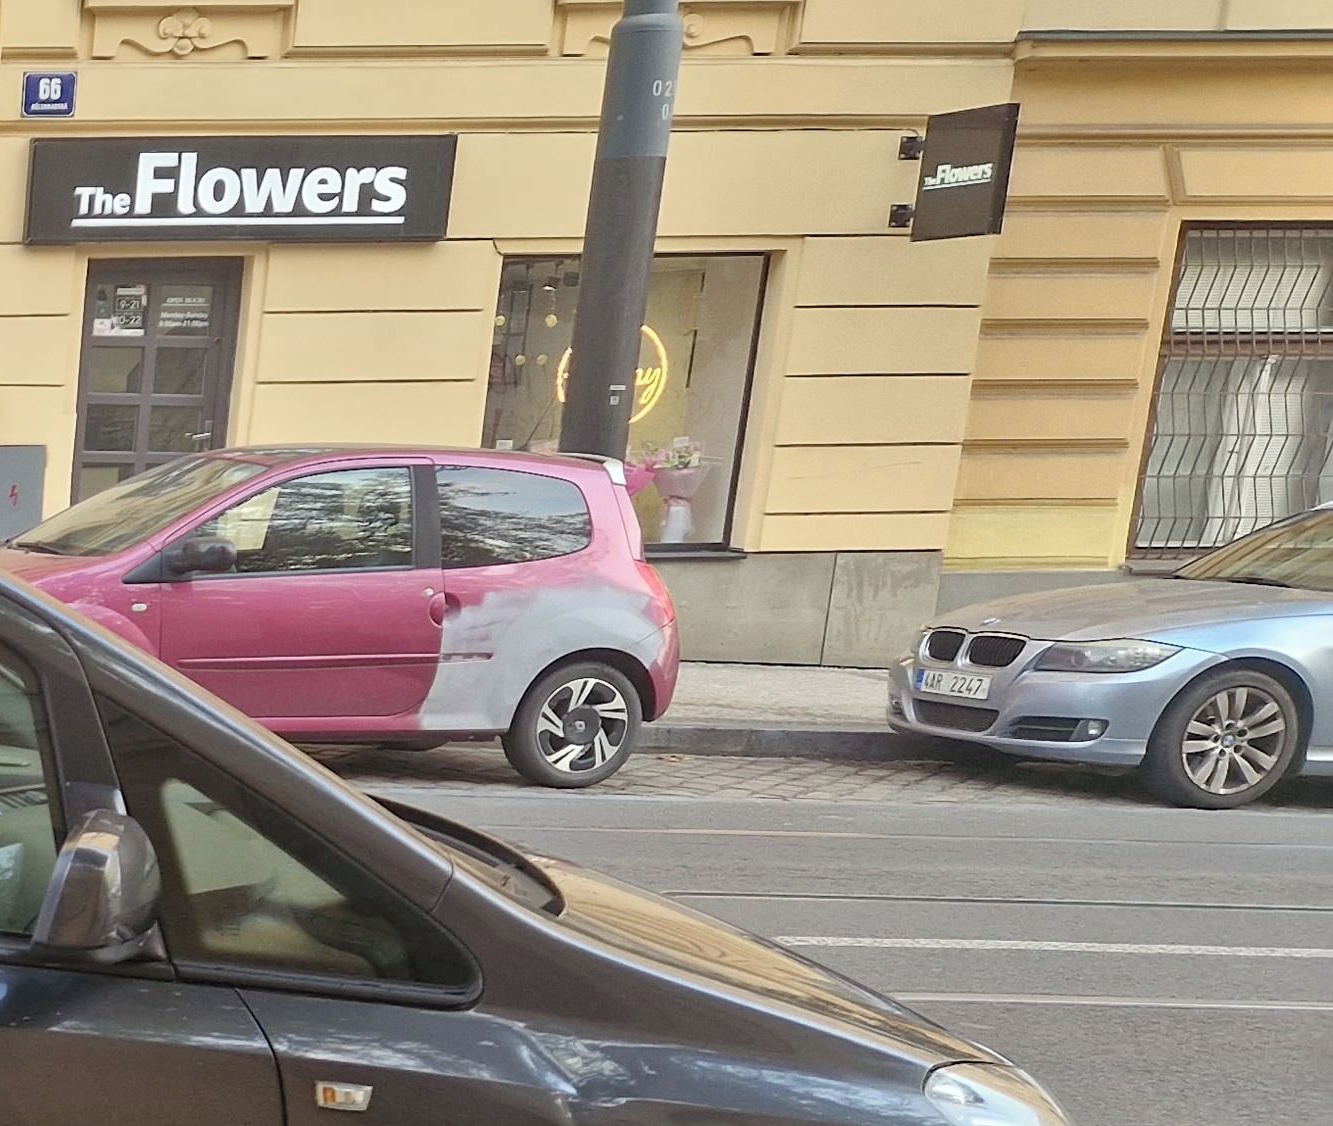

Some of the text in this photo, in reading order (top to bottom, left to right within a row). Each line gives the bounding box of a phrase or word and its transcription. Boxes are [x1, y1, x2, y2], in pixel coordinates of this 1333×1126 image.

[38, 77, 62, 100] 66
[74, 151, 408, 215] The Flowers
[936, 163, 993, 184] Flowers
[949, 675, 984, 697] 2247
